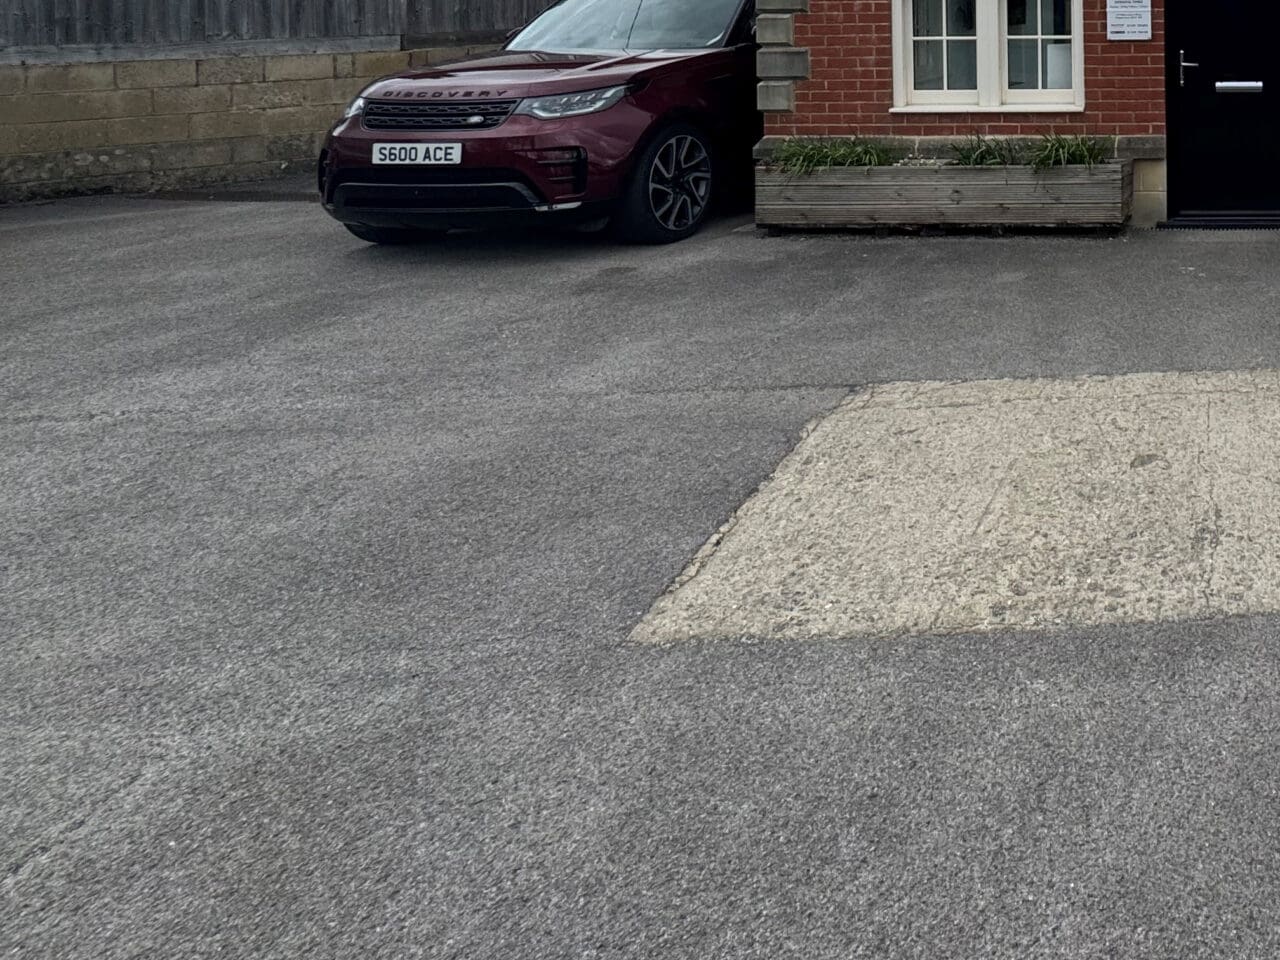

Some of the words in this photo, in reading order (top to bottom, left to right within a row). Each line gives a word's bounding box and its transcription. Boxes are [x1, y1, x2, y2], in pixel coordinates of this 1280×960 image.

[382, 90, 507, 98] DISCOVERY
[378, 146, 418, 162] S600
[422, 146, 455, 162] ACE
